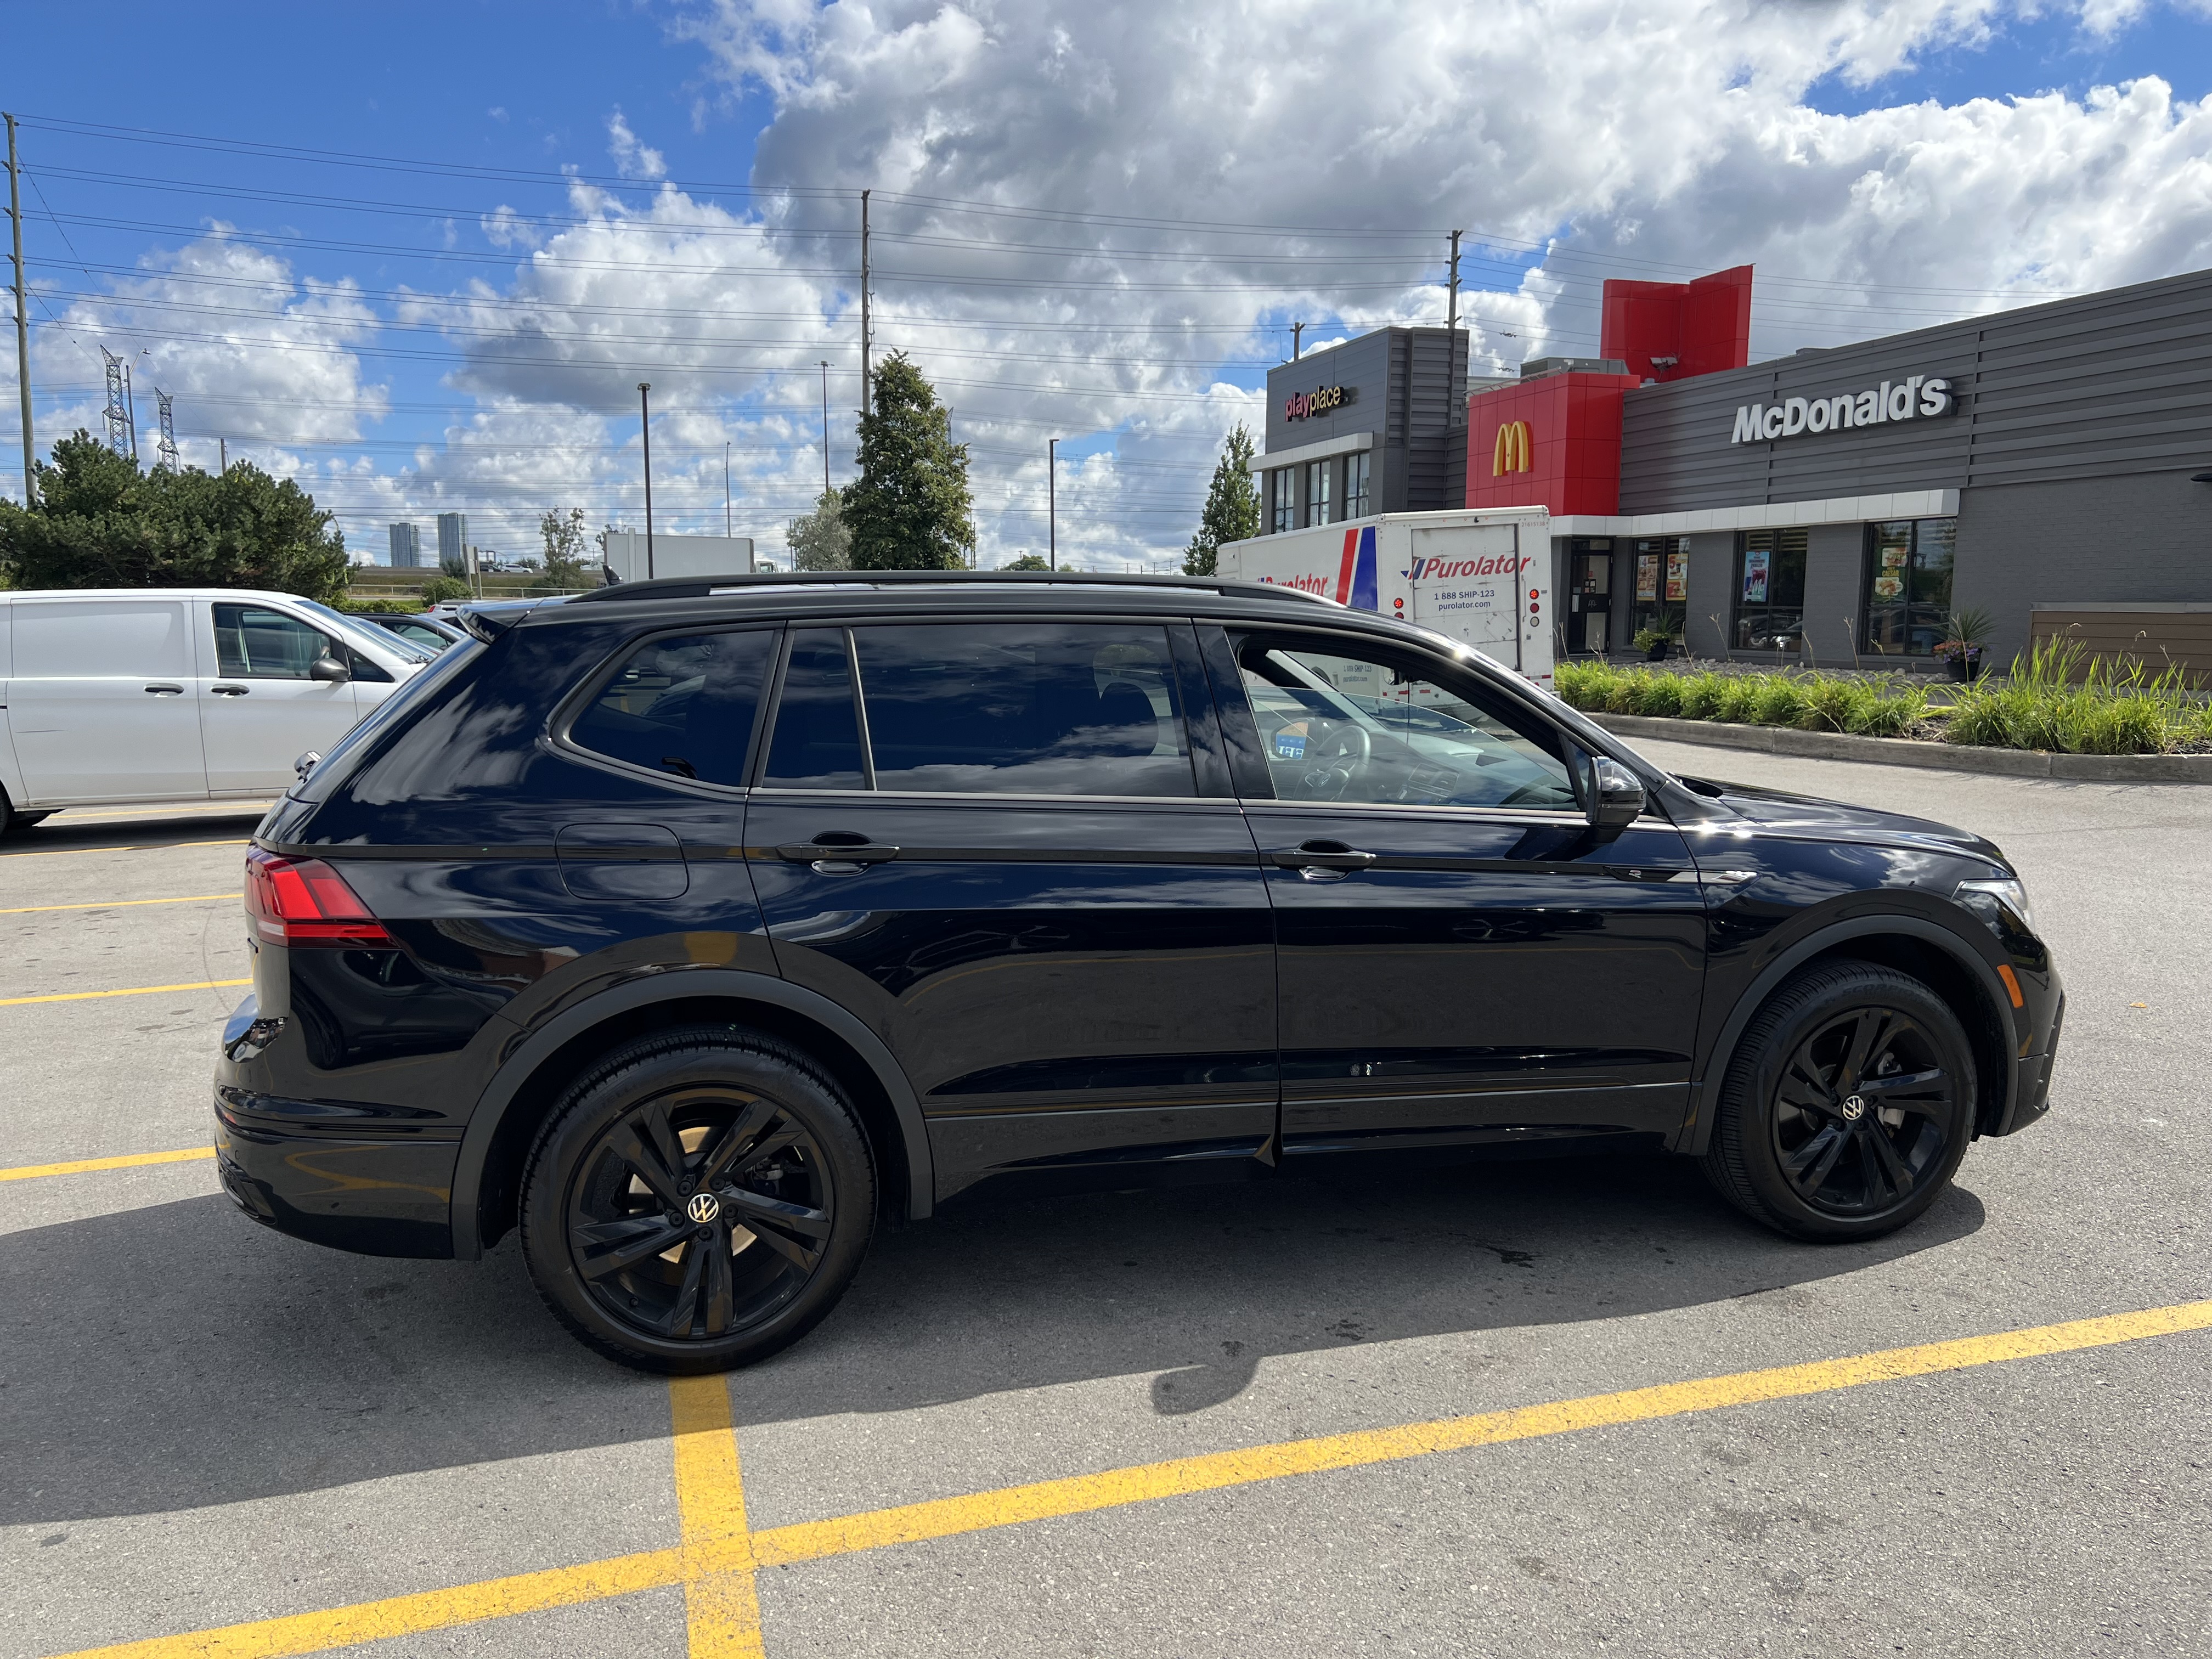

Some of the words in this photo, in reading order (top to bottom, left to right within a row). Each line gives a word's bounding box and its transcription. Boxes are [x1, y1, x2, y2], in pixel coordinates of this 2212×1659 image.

[1285, 386, 1342, 422] playplace
[1731, 375, 1949, 444] McDonald's
[1423, 555, 1531, 579] Purolator
[1438, 600, 1491, 611] purolator.com
[1459, 590, 1494, 599] SHIP-123
